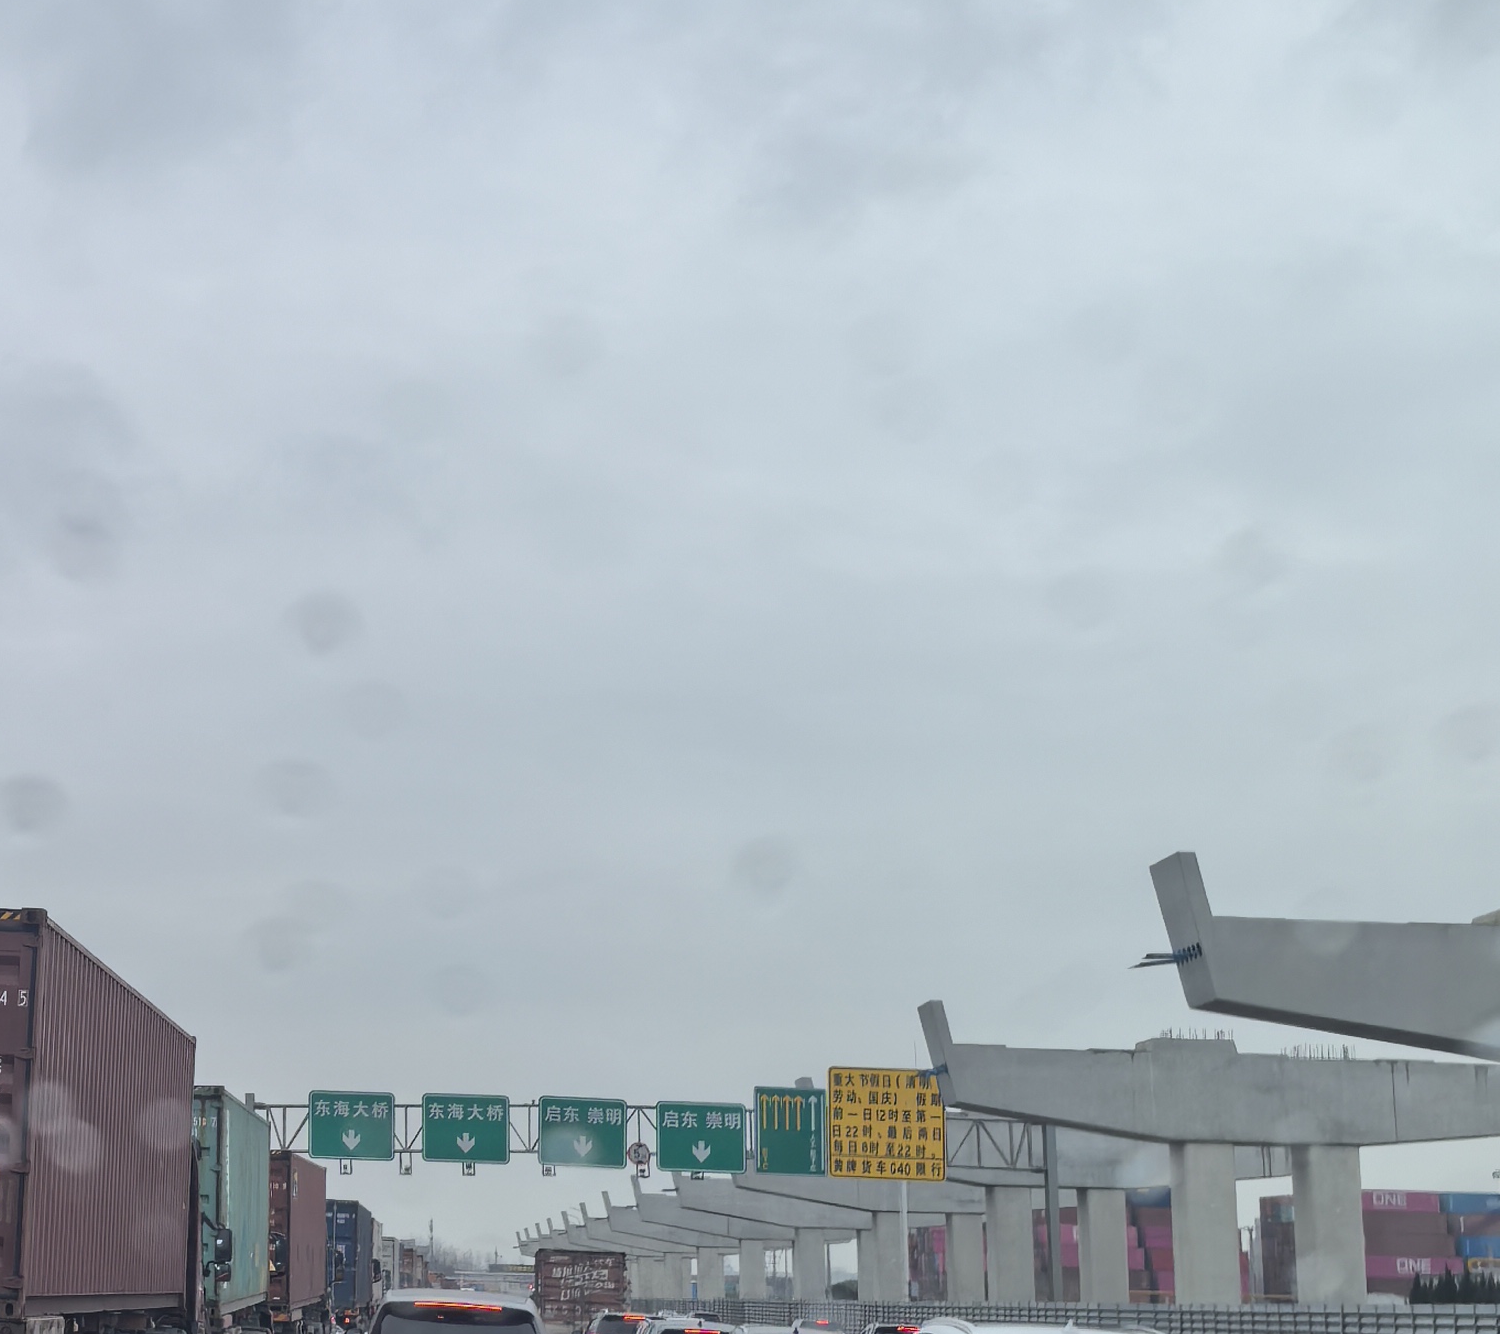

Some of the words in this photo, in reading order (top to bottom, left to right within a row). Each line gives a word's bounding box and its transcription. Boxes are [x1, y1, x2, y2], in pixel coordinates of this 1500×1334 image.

[19, 990, 28, 1006] 5
[314, 1099, 389, 1120] 东海大桥
[428, 1102, 504, 1122] 东海大桥
[544, 1105, 580, 1123] 启东
[587, 1106, 623, 1126] 崇明
[662, 1110, 698, 1128] 启东
[705, 1111, 741, 1130] 崇明
[833, 1158, 942, 1178] 黄牌货车G40限行
[1372, 1192, 1407, 1208] ONE
[1396, 1257, 1431, 1274] ONE
